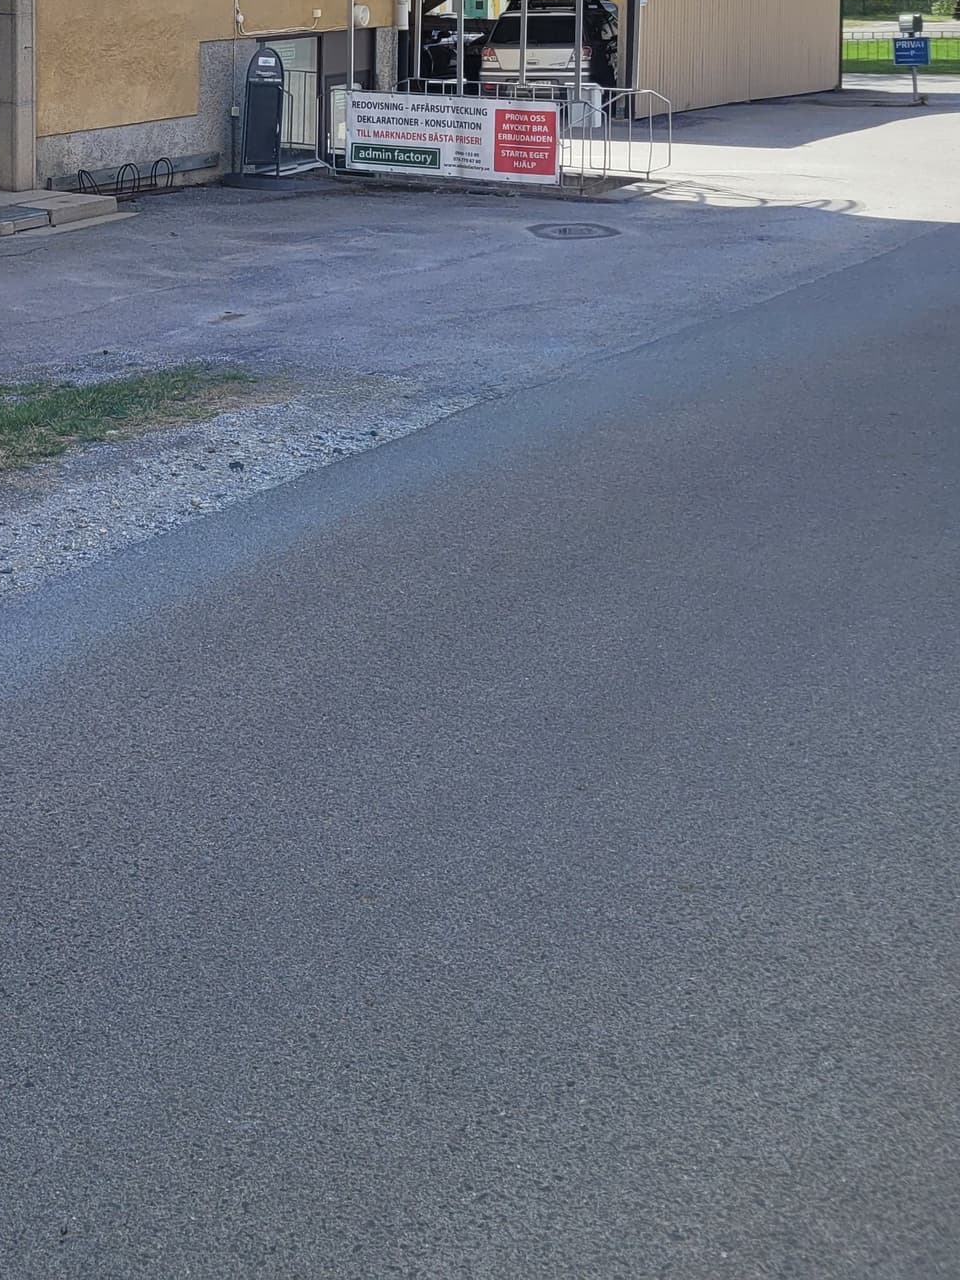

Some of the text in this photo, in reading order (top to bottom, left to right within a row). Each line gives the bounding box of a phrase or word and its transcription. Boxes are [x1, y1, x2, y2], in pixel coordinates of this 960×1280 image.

[351, 100, 403, 111] REDOVISNING
[411, 103, 488, 116] AFFÄRSUTVECKLING
[356, 115, 419, 127] DEKLARATIONER
[424, 119, 482, 130] KONSULTATION
[505, 113, 529, 122] PROVA
[502, 123, 549, 133] MYCKET BRA
[356, 128, 482, 145] TILL MARKNADENS BÄSTA PRISER!
[497, 133, 553, 143] ERBJUDANDEN
[358, 148, 433, 165] admin factory
[500, 149, 549, 160] STARTA EGET
[513, 160, 537, 169] HJÄLP
